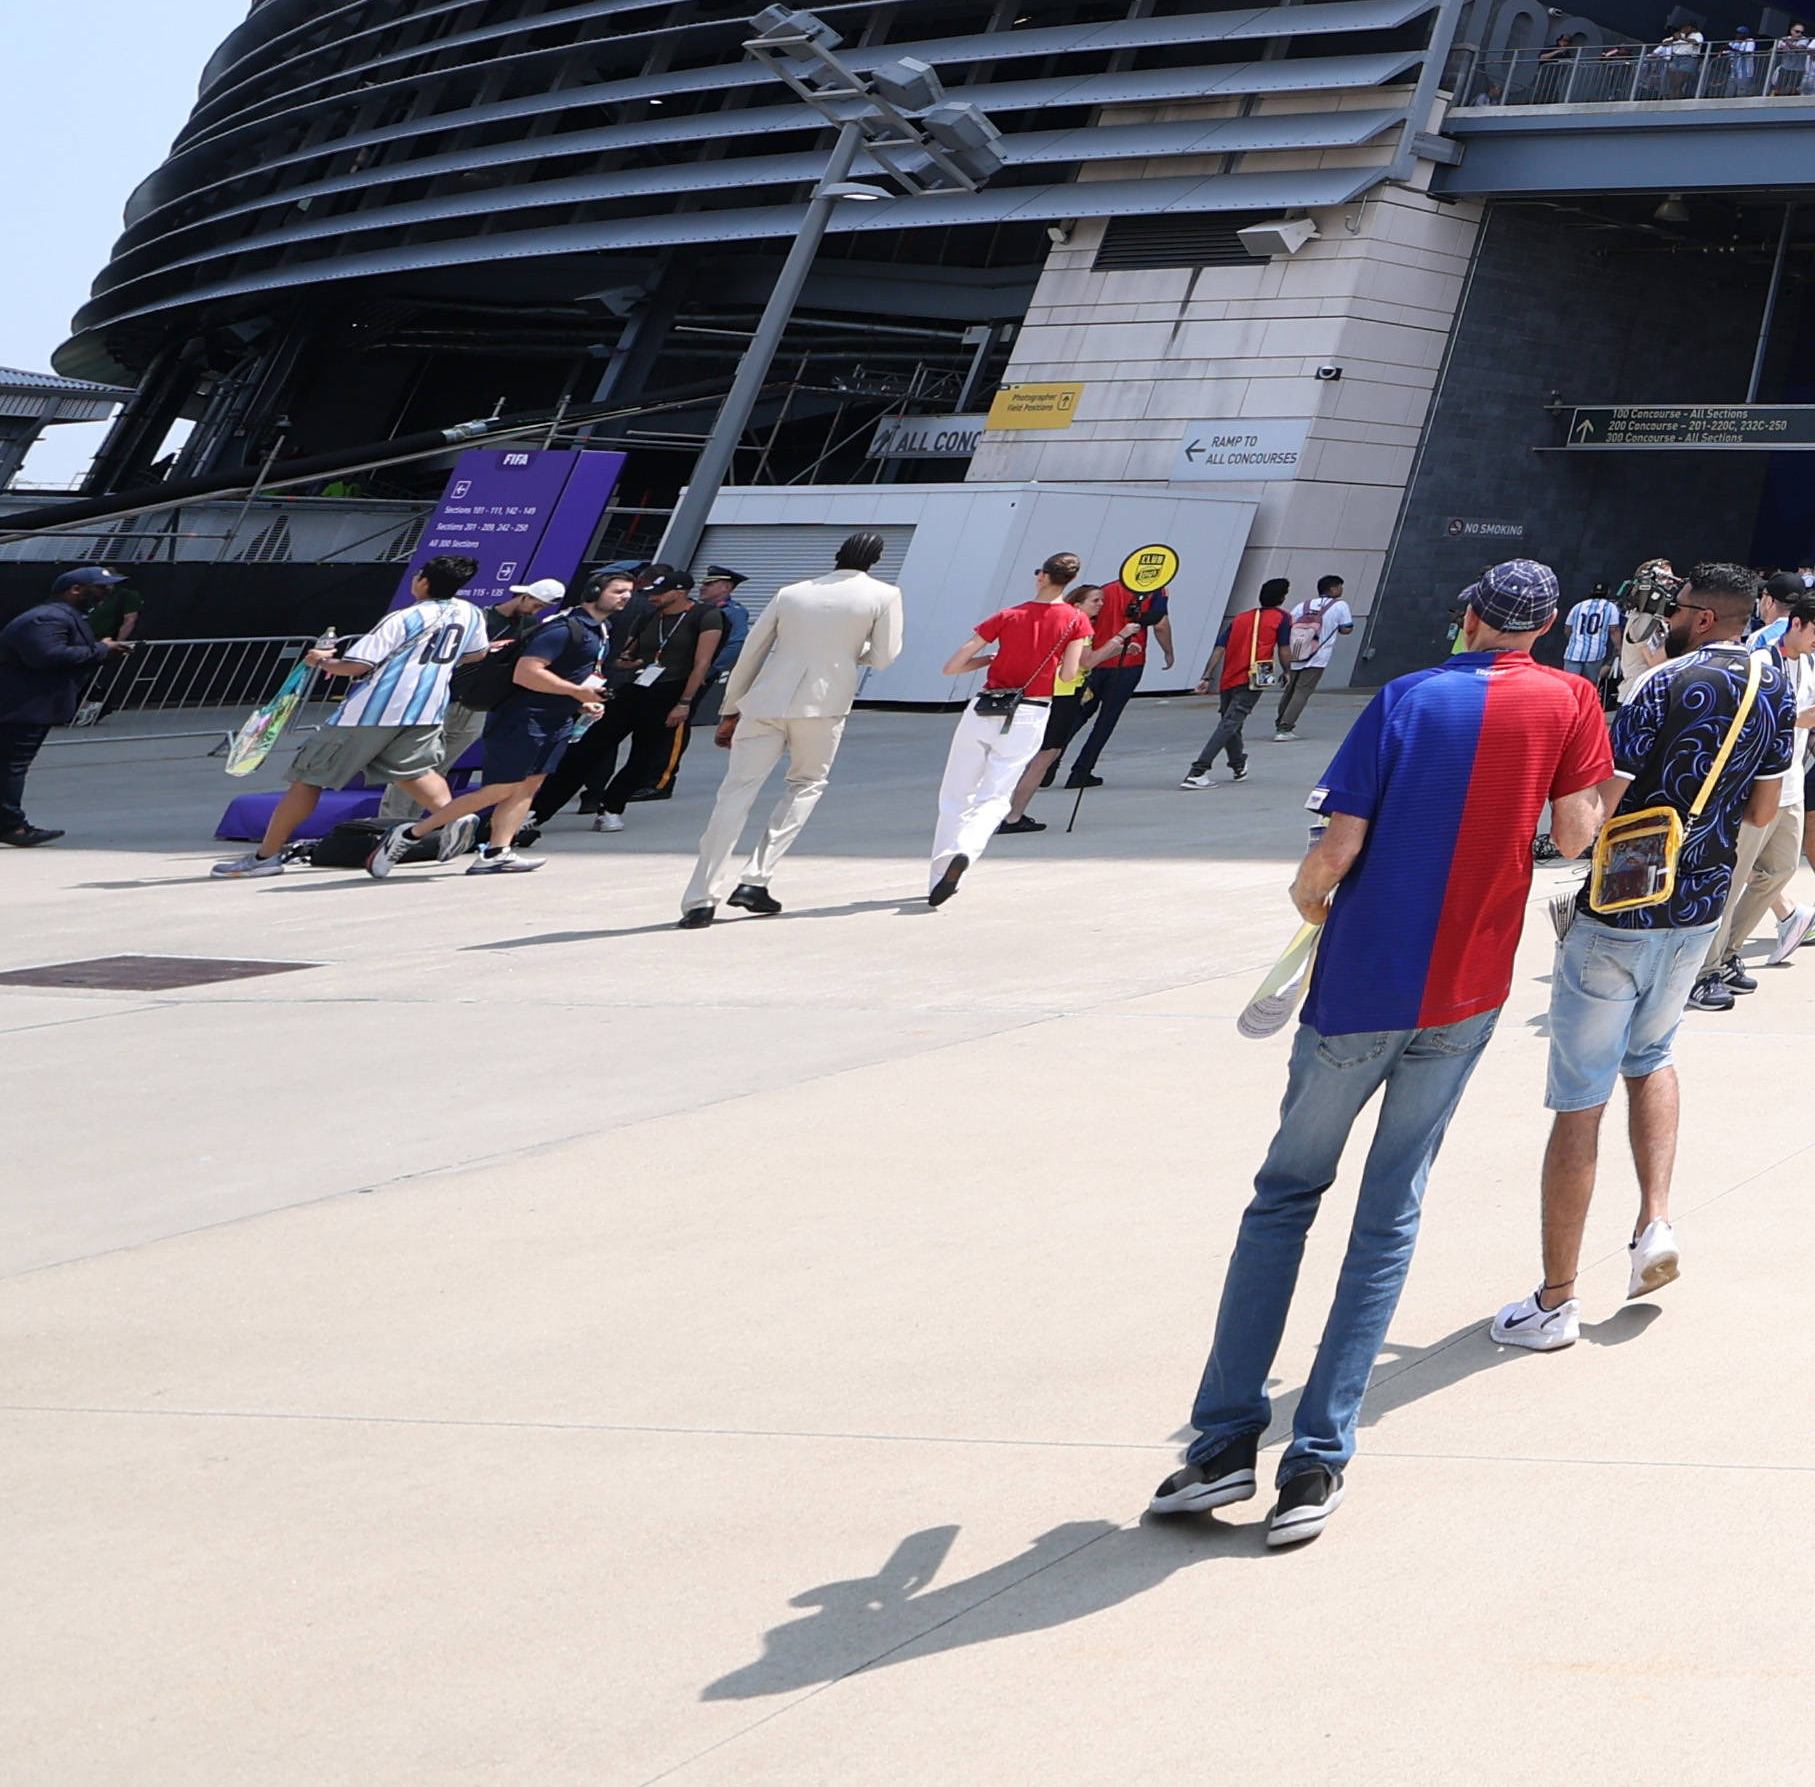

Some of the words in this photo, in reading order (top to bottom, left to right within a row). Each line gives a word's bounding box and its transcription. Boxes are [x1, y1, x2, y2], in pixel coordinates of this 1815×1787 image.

[1012, 393, 1057, 403] Photographer
[1007, 403, 1023, 412] Field
[1024, 402, 1054, 412] Positions
[1631, 409, 1681, 419] Concourse
[1690, 409, 1704, 419] All
[1706, 409, 1748, 419] Sections
[1608, 421, 1626, 431] 200
[1628, 421, 1678, 431] Concourse
[1688, 421, 1738, 432] 201-220C,
[1740, 421, 1787, 431] 232C-250
[895, 431, 931, 452] ALL
[1211, 436, 1242, 448] RAMP
[1243, 435, 1258, 447] TO
[1605, 433, 1623, 443] 300
[1625, 433, 1676, 443] Concourse
[1685, 433, 1699, 443] All
[1701, 433, 1743, 443] Sections
[503, 454, 529, 465] FIFA
[1206, 454, 1224, 465] ALL
[1227, 452, 1298, 465] CONCOURSES
[444, 506, 471, 515] Sections
[436, 522, 464, 531] Sections
[1464, 523, 1479, 533] NO
[1480, 523, 1523, 535] SMOKING
[451, 539, 480, 548] Sections
[1580, 613, 1601, 635] 10
[418, 623, 465, 665] 10
